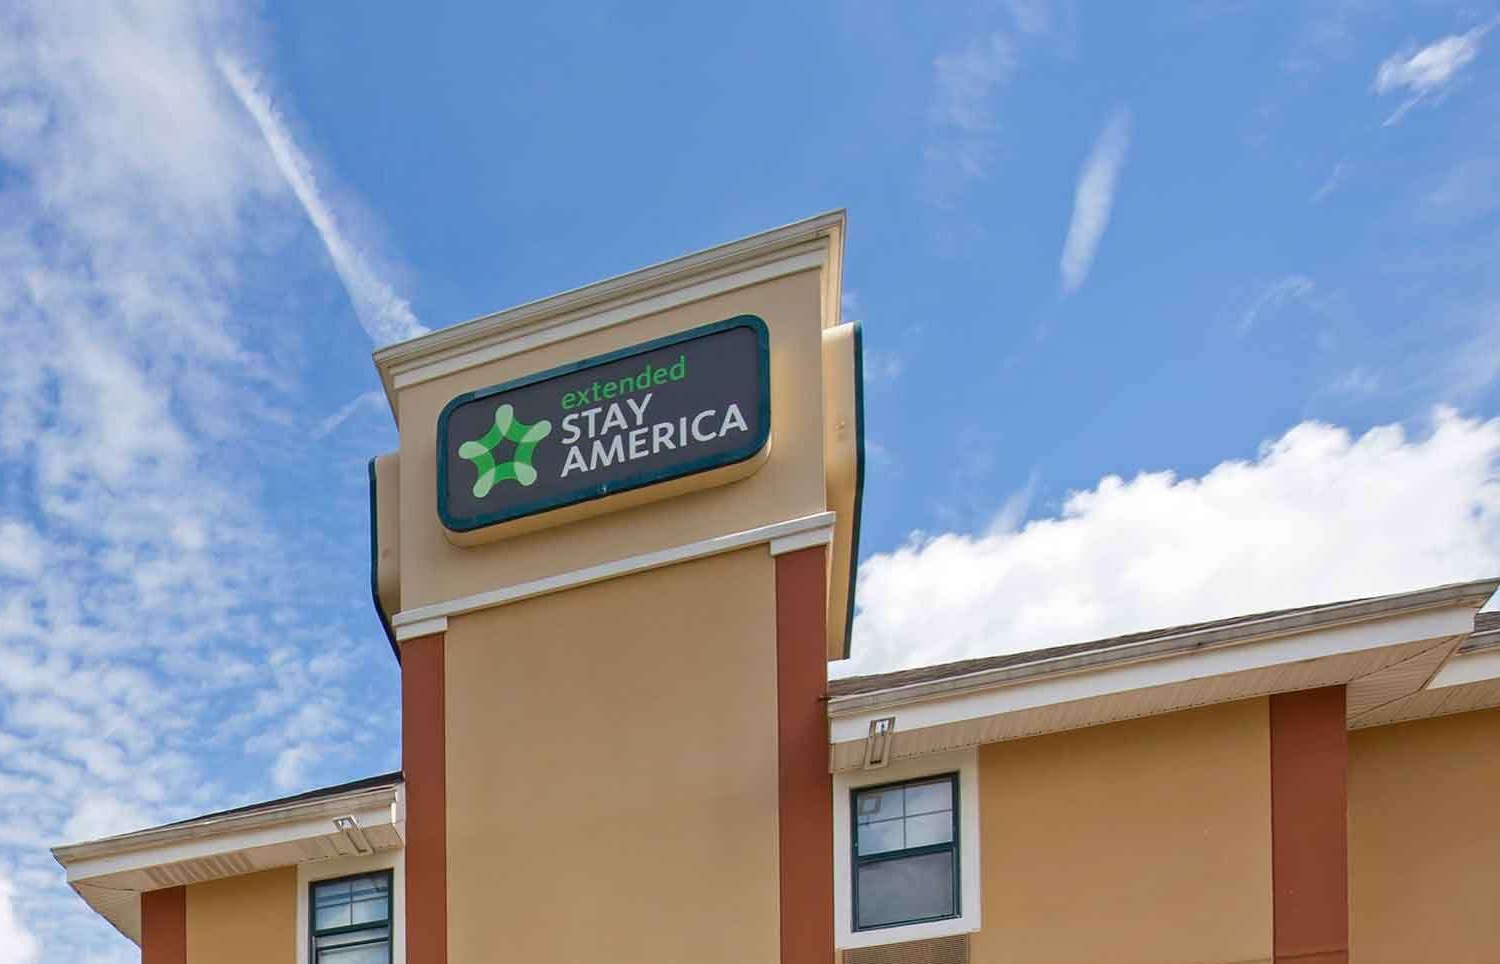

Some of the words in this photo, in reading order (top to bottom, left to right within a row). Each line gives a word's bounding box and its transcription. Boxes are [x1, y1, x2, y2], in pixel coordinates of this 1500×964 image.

[561, 355, 686, 409] extended
[560, 403, 748, 478] AMERICA
[561, 393, 653, 445] STAY
